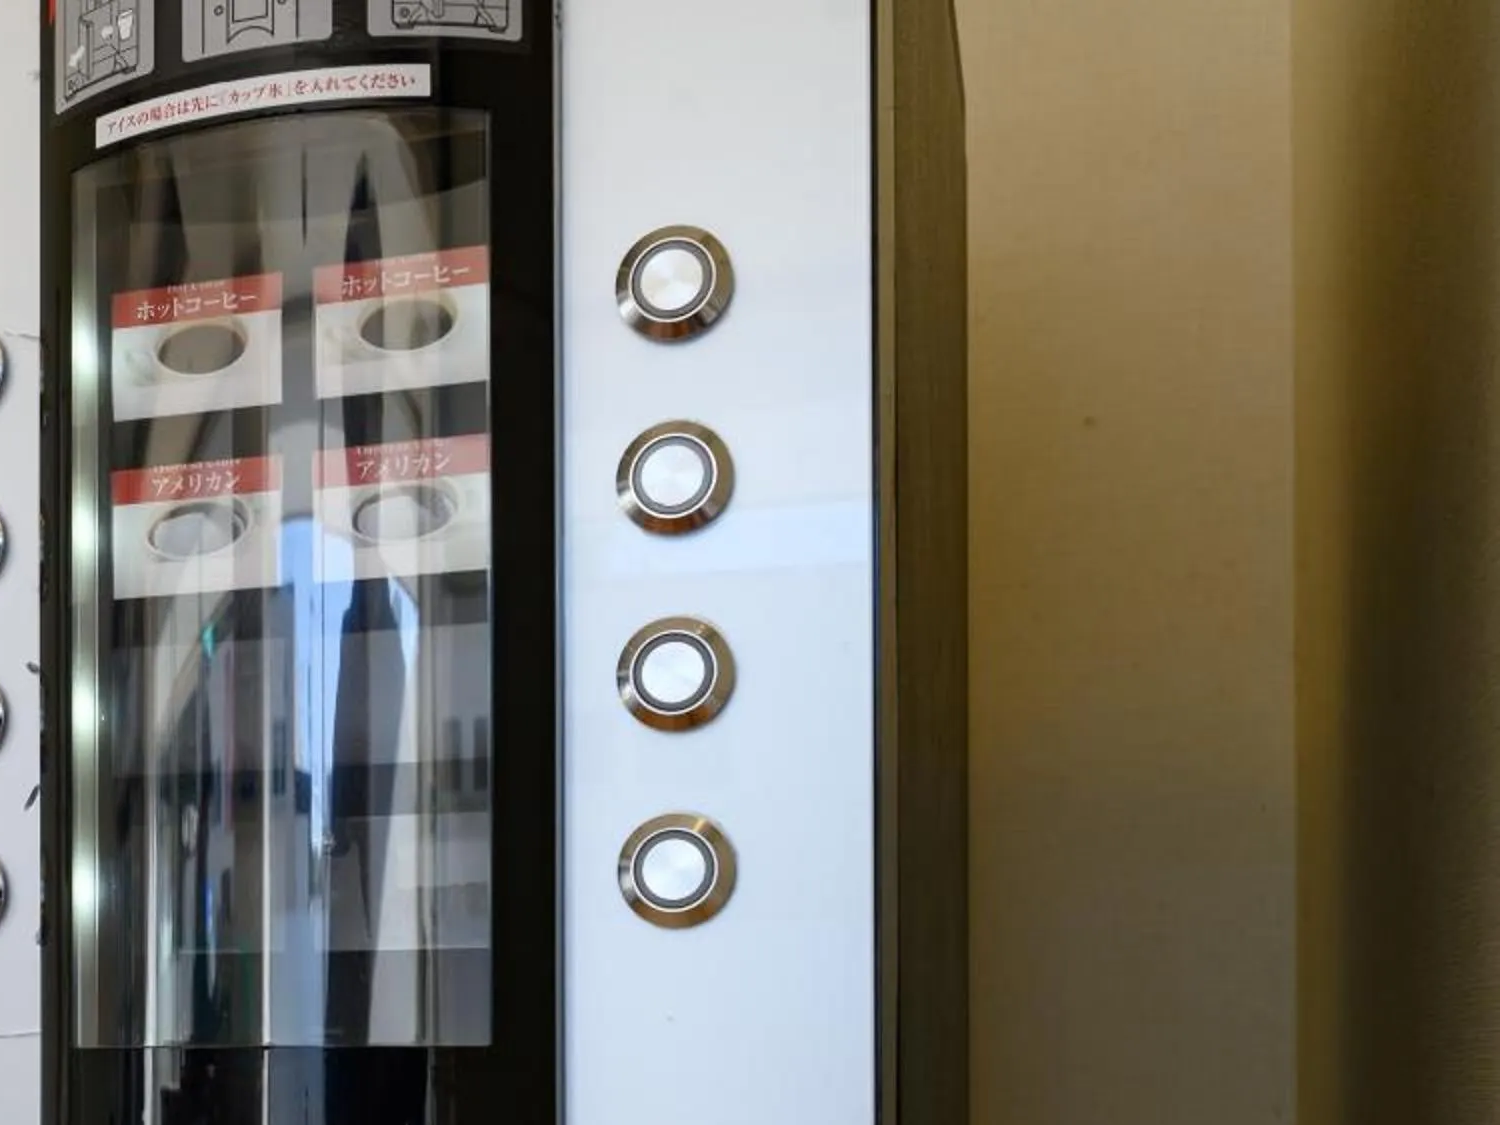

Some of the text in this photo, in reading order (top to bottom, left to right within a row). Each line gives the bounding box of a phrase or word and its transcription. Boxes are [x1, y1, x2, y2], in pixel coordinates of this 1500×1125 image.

[343, 264, 471, 297] ホットコーヒー
[136, 291, 257, 322] ホットコーヒー
[356, 453, 451, 480] アメリカン
[151, 471, 243, 497] アメリカン
